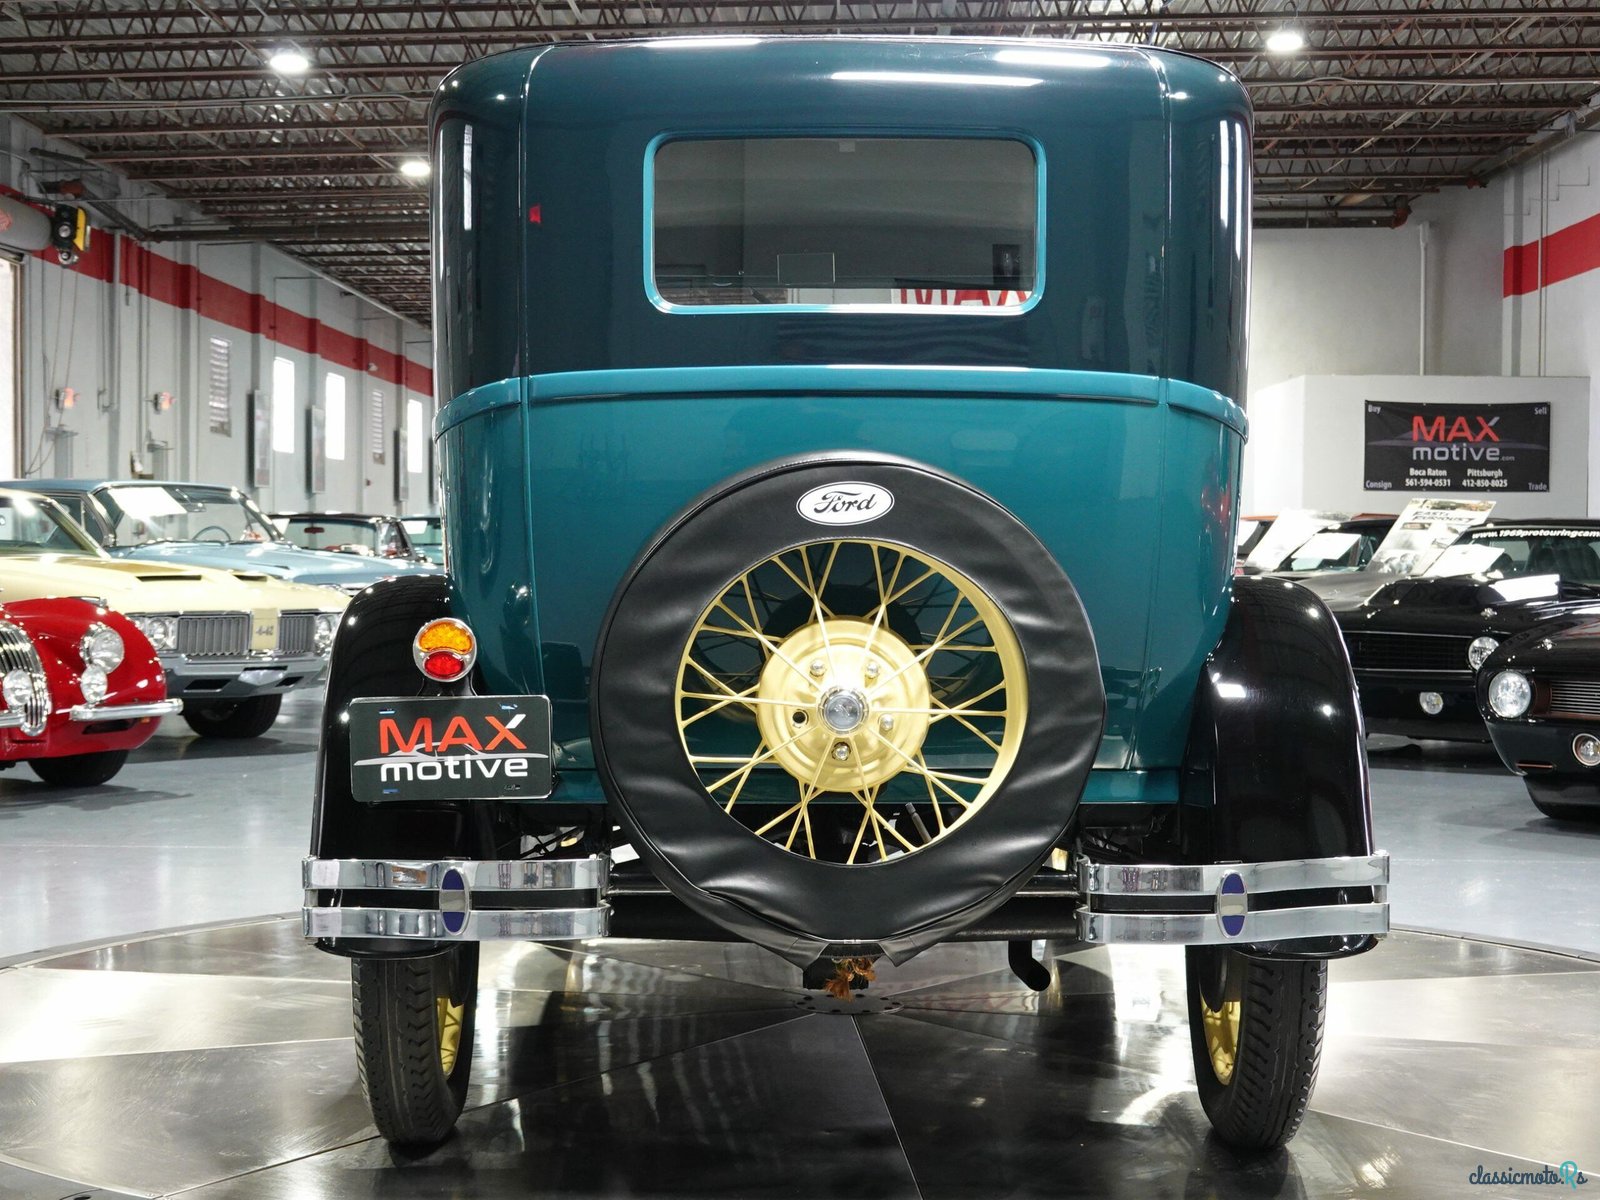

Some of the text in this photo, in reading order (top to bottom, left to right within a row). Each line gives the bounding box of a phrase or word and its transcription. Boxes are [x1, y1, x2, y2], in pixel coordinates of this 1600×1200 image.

[1368, 404, 1381, 415] Buy
[1534, 407, 1547, 415] Sell
[1412, 416, 1500, 442] MAX
[1409, 467, 1447, 477] Boca Raton
[1467, 468, 1503, 478] Pittsburgh
[1365, 480, 1392, 490] Consign
[1405, 478, 1451, 487] 561-594-0531
[1528, 482, 1547, 491] Trade
[813, 490, 878, 514] Ford
[379, 713, 527, 754] MAX
[380, 754, 528, 782] motive
